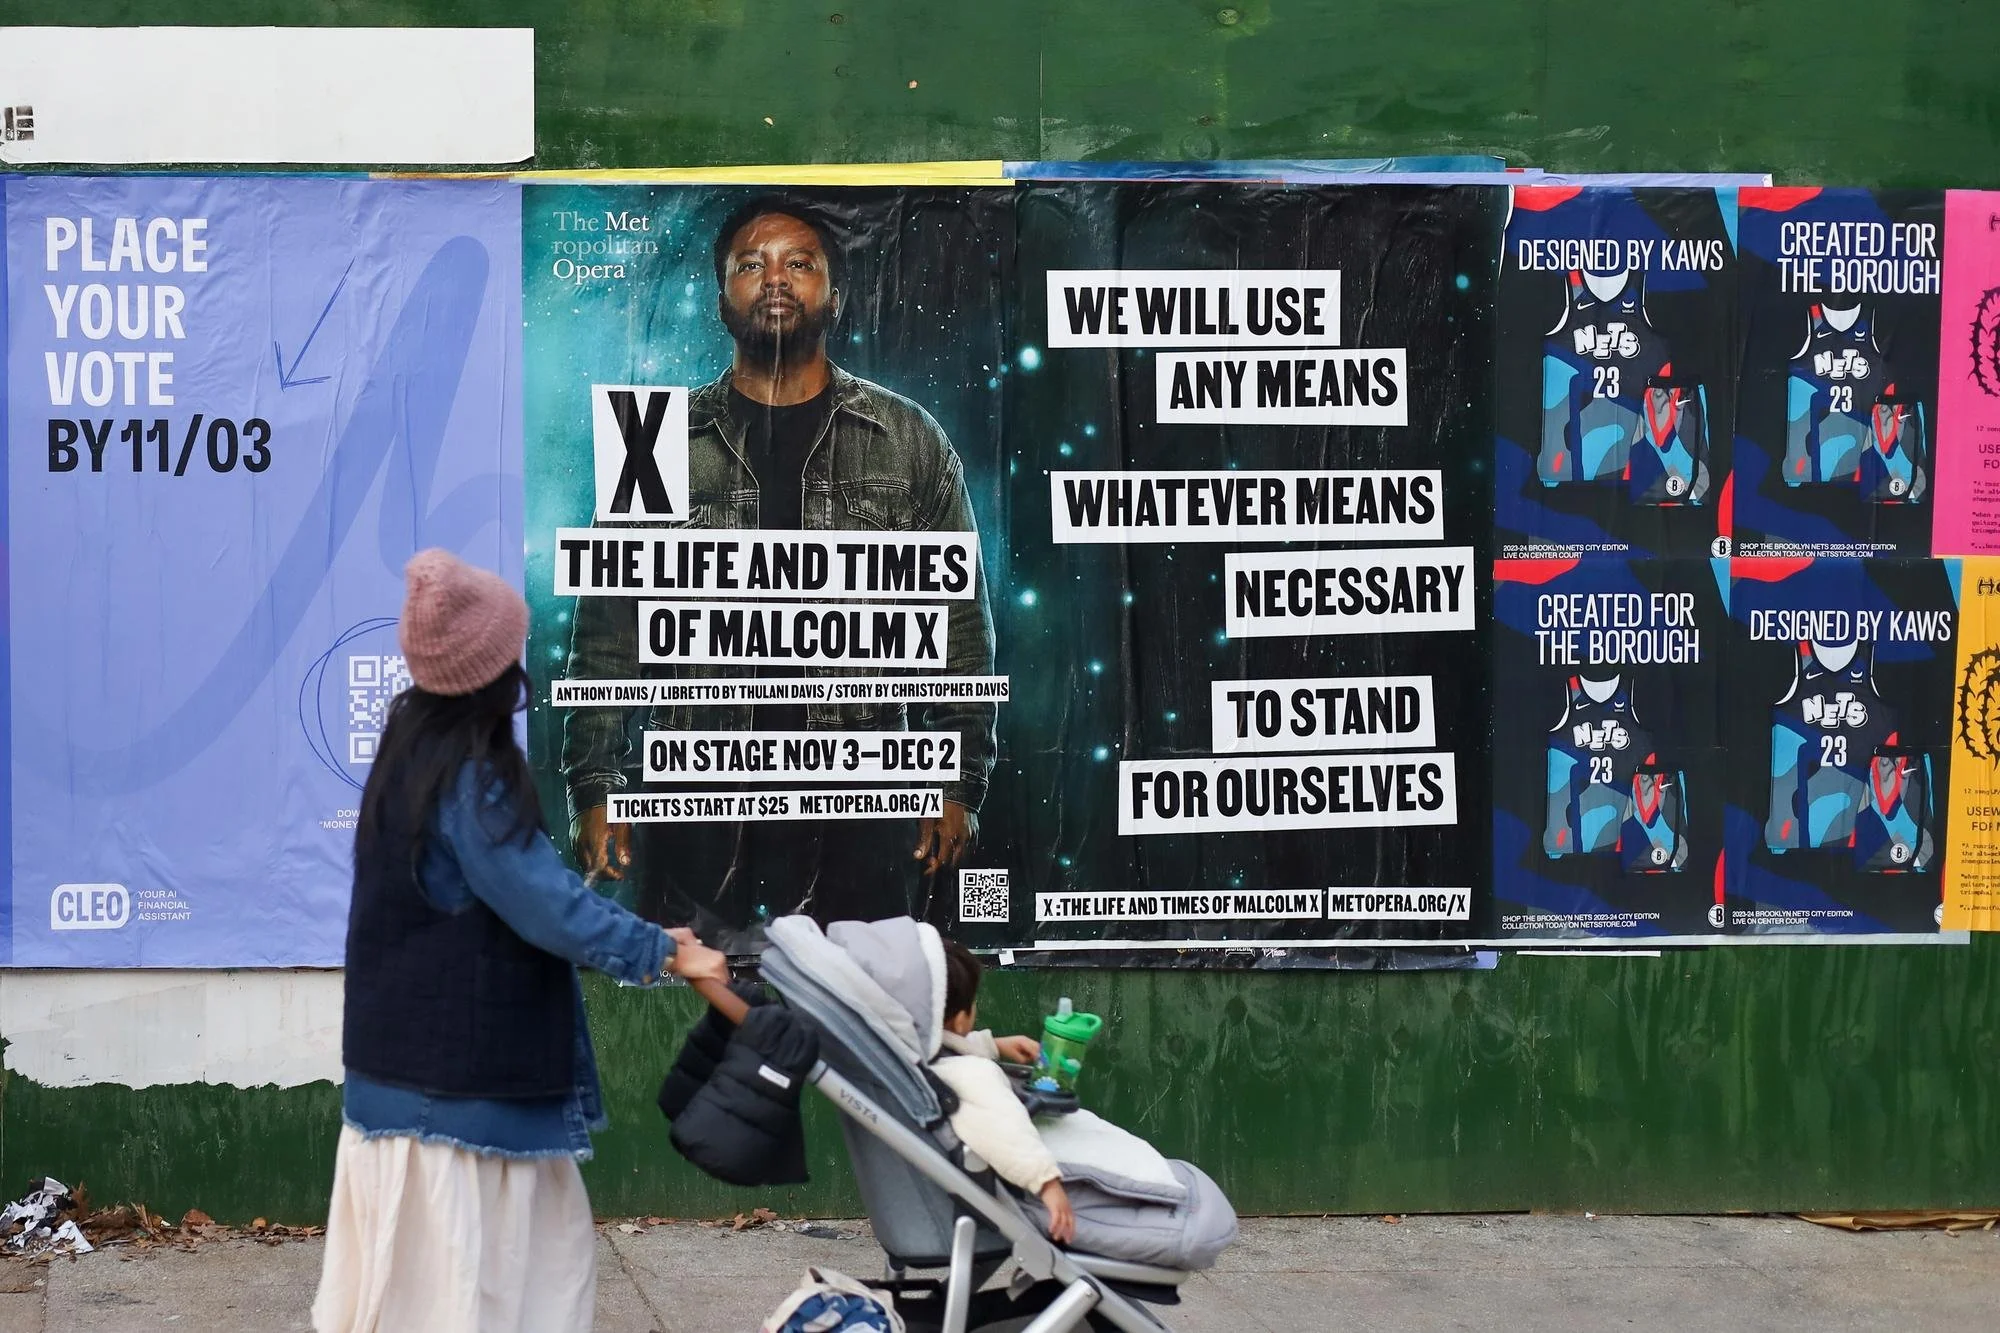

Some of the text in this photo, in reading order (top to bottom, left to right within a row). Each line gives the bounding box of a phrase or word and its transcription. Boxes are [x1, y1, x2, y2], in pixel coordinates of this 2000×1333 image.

[552, 211, 650, 233] The Met
[45, 217, 208, 272] PLACE
[551, 236, 659, 260] ropolitan
[1518, 239, 1724, 271] DESIGNED BY KAWS
[1781, 222, 1936, 258] CREATED FOR
[552, 259, 626, 286] Opera
[1777, 258, 1942, 295] THE BOROUGH
[44, 284, 187, 340] YOUR
[1063, 287, 1326, 336] WE WILL USE
[1573, 321, 1641, 359] NETS
[44, 351, 175, 406] VOTE
[1813, 348, 1870, 380] NETS
[1169, 357, 1399, 410] ANY MEANS
[1593, 367, 1620, 399] 23
[1830, 386, 1853, 413] 23
[47, 413, 273, 477] BY 11/03
[607, 391, 674, 514] X
[1063, 475, 1435, 528] WHATEVER MEANS
[1503, 544, 1528, 552] 2023-24
[1601, 543, 1629, 551] EDITION
[1558, 551, 1584, 559] COURT
[1739, 542, 1759, 550] SHOP
[1829, 543, 1854, 551] 2023-24
[1870, 543, 1897, 551] EDITION
[1739, 550, 1782, 558] COLLECTION
[1782, 550, 1806, 558] TODAY
[560, 539, 969, 593] THE LIFE AND TIMES
[1235, 565, 1465, 618] NECESSARY
[1537, 592, 1696, 628] CREATED FOR
[1749, 610, 1952, 642] DESIGNED BY KAWS
[648, 608, 939, 660] OF MALCOLM X
[1535, 628, 1700, 666] THE BOROUGH
[556, 686, 613, 702] ANTHONY
[615, 686, 648, 701] DAVIS
[660, 684, 720, 700] LIBRETTO
[722, 684, 738, 699] BY
[738, 683, 789, 699] THULANI
[791, 683, 825, 699] DAVIS
[835, 683, 873, 698] STORY
[874, 682, 890, 698] BY
[891, 682, 974, 697] CHRISTOPHER
[975, 682, 1008, 697] DAVIS
[1227, 686, 1421, 738] TO STAND
[1801, 691, 1867, 728] NETS
[1573, 720, 1630, 751] NETS
[1820, 736, 1847, 767] 23
[649, 740, 687, 772] ON
[692, 739, 777, 771] STAGE
[782, 739, 837, 771] NOV
[938, 738, 956, 770] 2
[1589, 757, 1613, 784] 23
[613, 793, 940, 818] TICKETS START AT $25 METOPERA.ORG/X
[1131, 762, 1444, 820] FOR OURSELVES
[57, 891, 123, 922] CLEO
[138, 890, 178, 899] YOUR AI
[138, 902, 190, 910] FINANCIAL
[1094, 897, 1127, 915] LIFE
[1128, 897, 1159, 915] AND
[1160, 896, 1210, 914] TIMES
[1211, 896, 1231, 914] OF
[1233, 895, 1308, 914] MALCOLM
[1309, 894, 1320, 912] X
[1332, 893, 1466, 914] METOPERA.ORG/X
[137, 912, 192, 921] ASSISTANT
[1502, 915, 1522, 923] SHOP
[1536, 914, 1574, 922] BROOKLYN
[1593, 913, 1617, 921] 2023-24
[1634, 912, 1660, 920] EDITION
[1502, 920, 1637, 930] COLLECTION TODAY ON NETSSTORE.COM
[1758, 917, 1784, 925] CENTER
[1827, 909, 1854, 917] EDITION
[840, 1088, 878, 1124] VISTA
